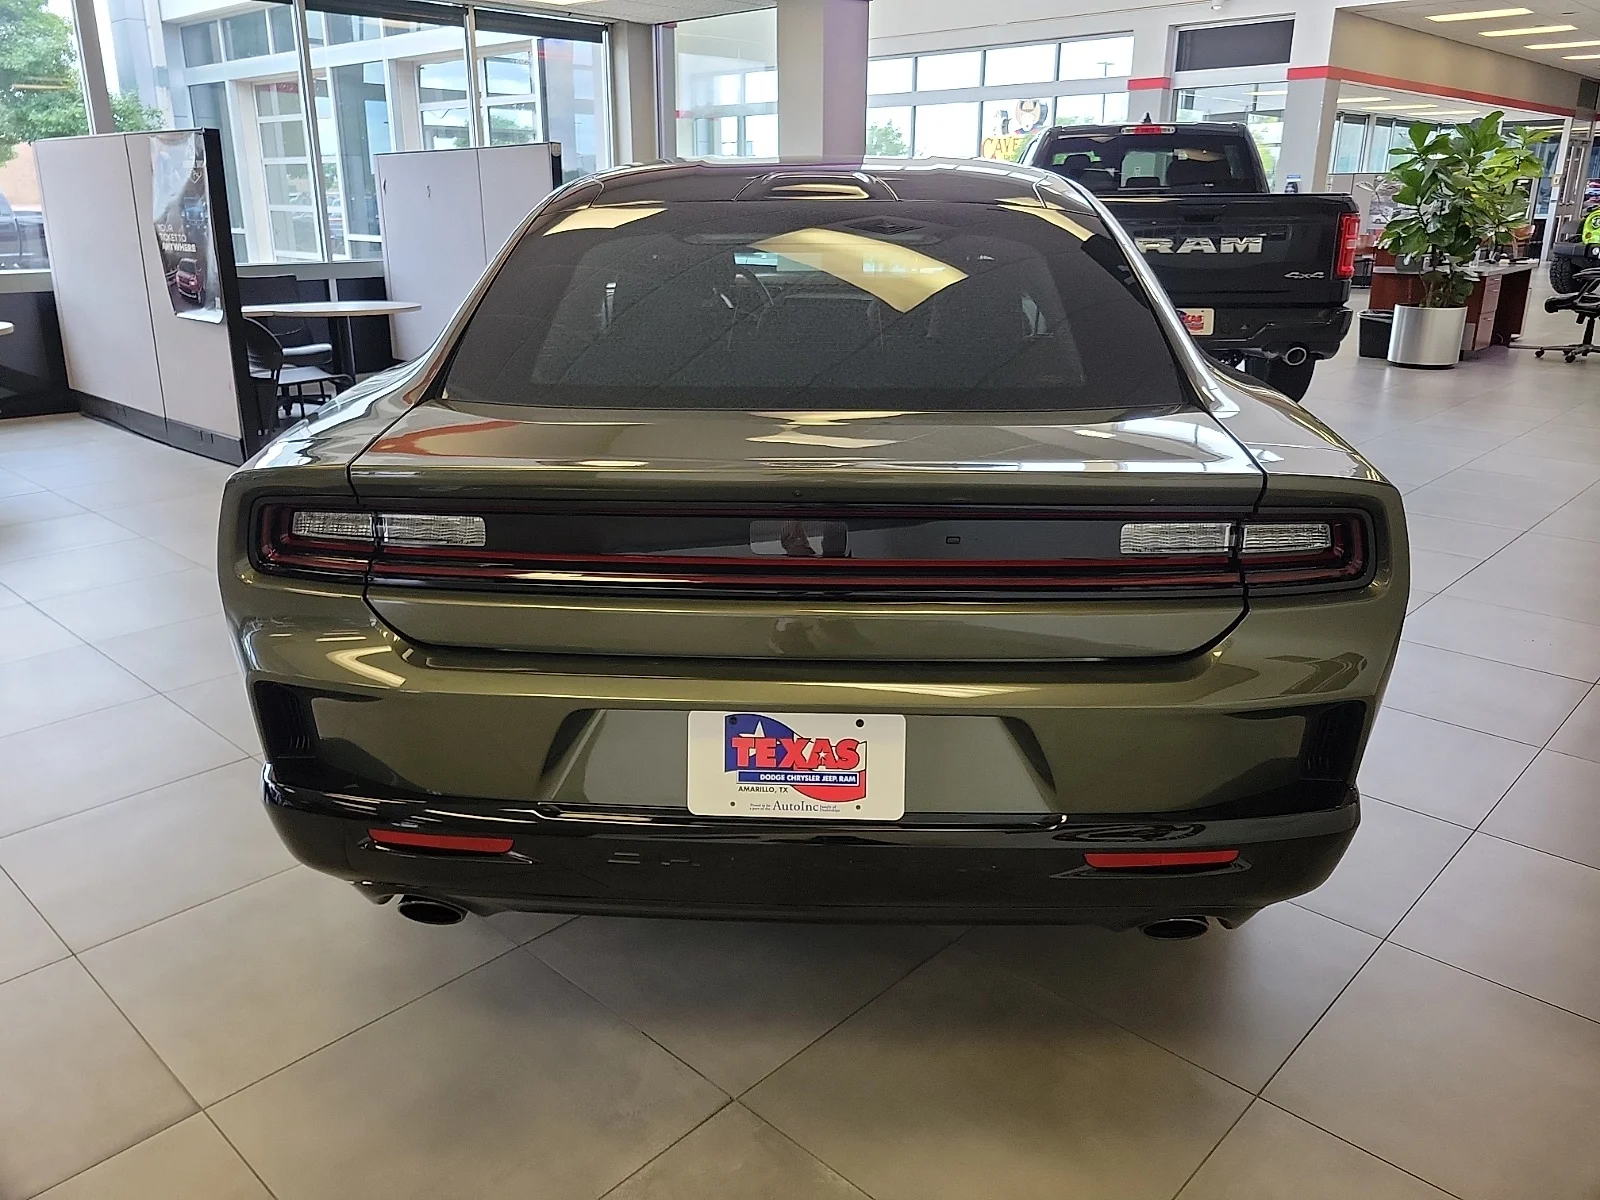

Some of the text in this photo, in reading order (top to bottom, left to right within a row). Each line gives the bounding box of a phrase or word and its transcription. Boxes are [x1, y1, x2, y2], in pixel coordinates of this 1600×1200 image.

[981, 137, 1021, 159] CAVE
[1134, 236, 1264, 254] RAM
[732, 737, 860, 770] TEXAS
[773, 800, 819, 812] AutoInc
